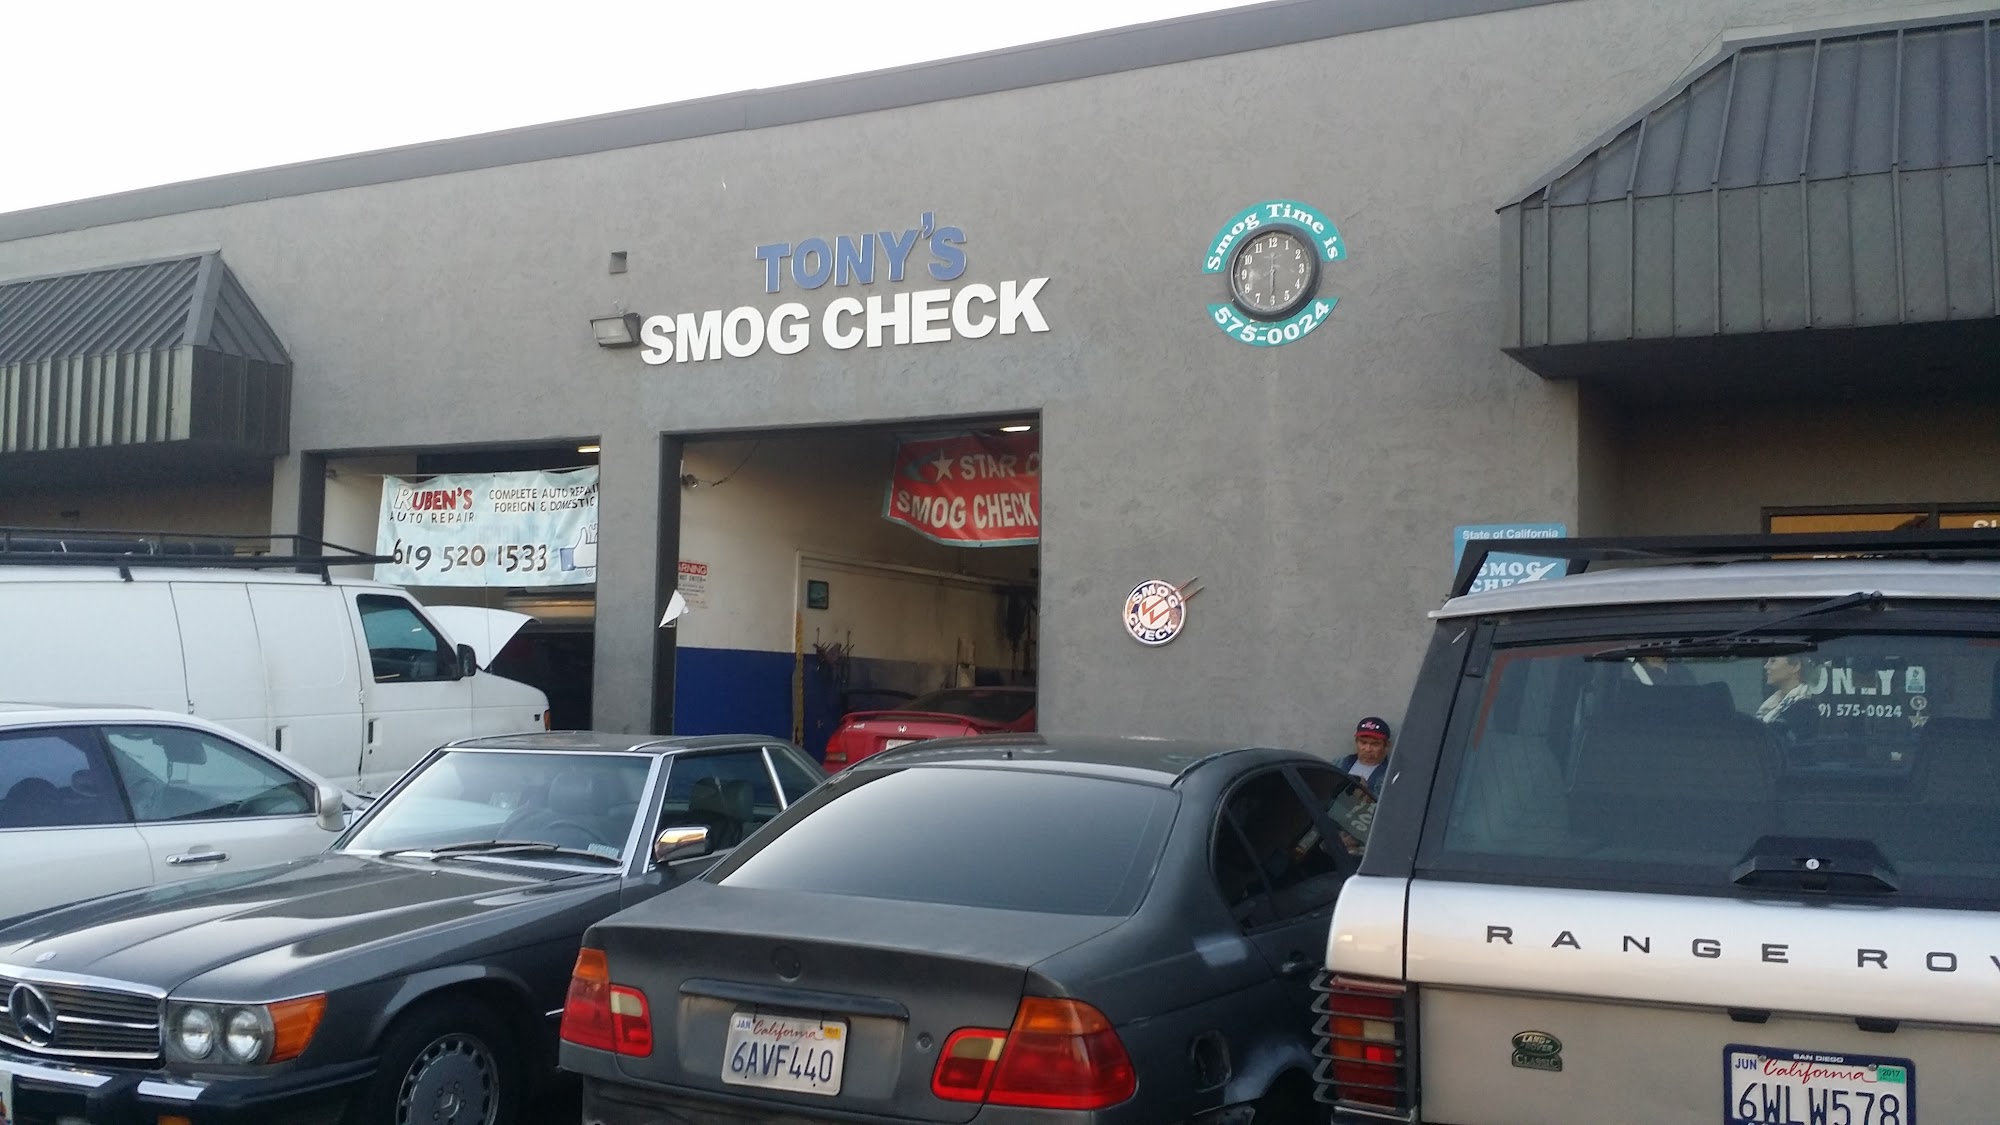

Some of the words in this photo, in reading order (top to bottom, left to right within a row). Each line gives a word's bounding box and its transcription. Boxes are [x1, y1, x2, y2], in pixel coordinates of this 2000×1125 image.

[1207, 211, 1260, 271] Smog
[1265, 203, 1325, 235] Time
[1323, 236, 1339, 260] is
[1268, 236, 1278, 248] 12
[1254, 243, 1263, 253] 11
[1284, 240, 1290, 249] 1
[755, 211, 967, 293] TONY'S
[1295, 249, 1301, 259] 2
[1244, 255, 1253, 265] 10
[1241, 269, 1247, 280] 9
[1299, 263, 1304, 274] 3
[1244, 283, 1250, 293] 8
[1294, 278, 1301, 289] 4
[1255, 293, 1261, 303] 7
[1269, 295, 1275, 305] 6
[1284, 290, 1290, 301] 5
[640, 302, 810, 365] SMOG
[822, 277, 1051, 350] CHECK
[1214, 301, 1330, 344] 575-0024
[959, 454, 1017, 480] STAR
[394, 487, 473, 511] RUBEN'S
[489, 488, 537, 500] COMPLETE
[542, 488, 568, 499] AUTO
[494, 501, 535, 513] FOREIGN
[550, 497, 595, 512] DOMESTIC
[897, 490, 966, 529] SMOG
[973, 492, 1038, 529] CHECK
[390, 511, 423, 524] AUTO
[431, 512, 475, 524] REPAIR
[1462, 530, 1490, 539] State
[1492, 529, 1503, 539] of
[1506, 528, 1559, 538] California
[394, 538, 431, 571] 619
[441, 545, 486, 573] 520
[498, 544, 547, 572] 1533
[1477, 561, 1542, 576] SMOG
[1132, 584, 1178, 608] SMOG
[1128, 613, 1177, 640] CHECK
[1836, 703, 1902, 718] 575-0024
[1486, 925, 1789, 963] RANGE
[736, 1020, 751, 1029] JAN
[753, 1020, 823, 1041] California
[1522, 1035, 1546, 1044] LAND
[731, 1041, 833, 1082] 6AVF440
[1515, 1054, 1559, 1068] CLASSIC
[1793, 1053, 1814, 1061] SAN
[1815, 1055, 1844, 1063] DIEGO
[1735, 1057, 1757, 1070] JUN
[1763, 1058, 1877, 1084] California
[1882, 1069, 1900, 1078] 2017
[1739, 1083, 1900, 1125] 6WLW578
